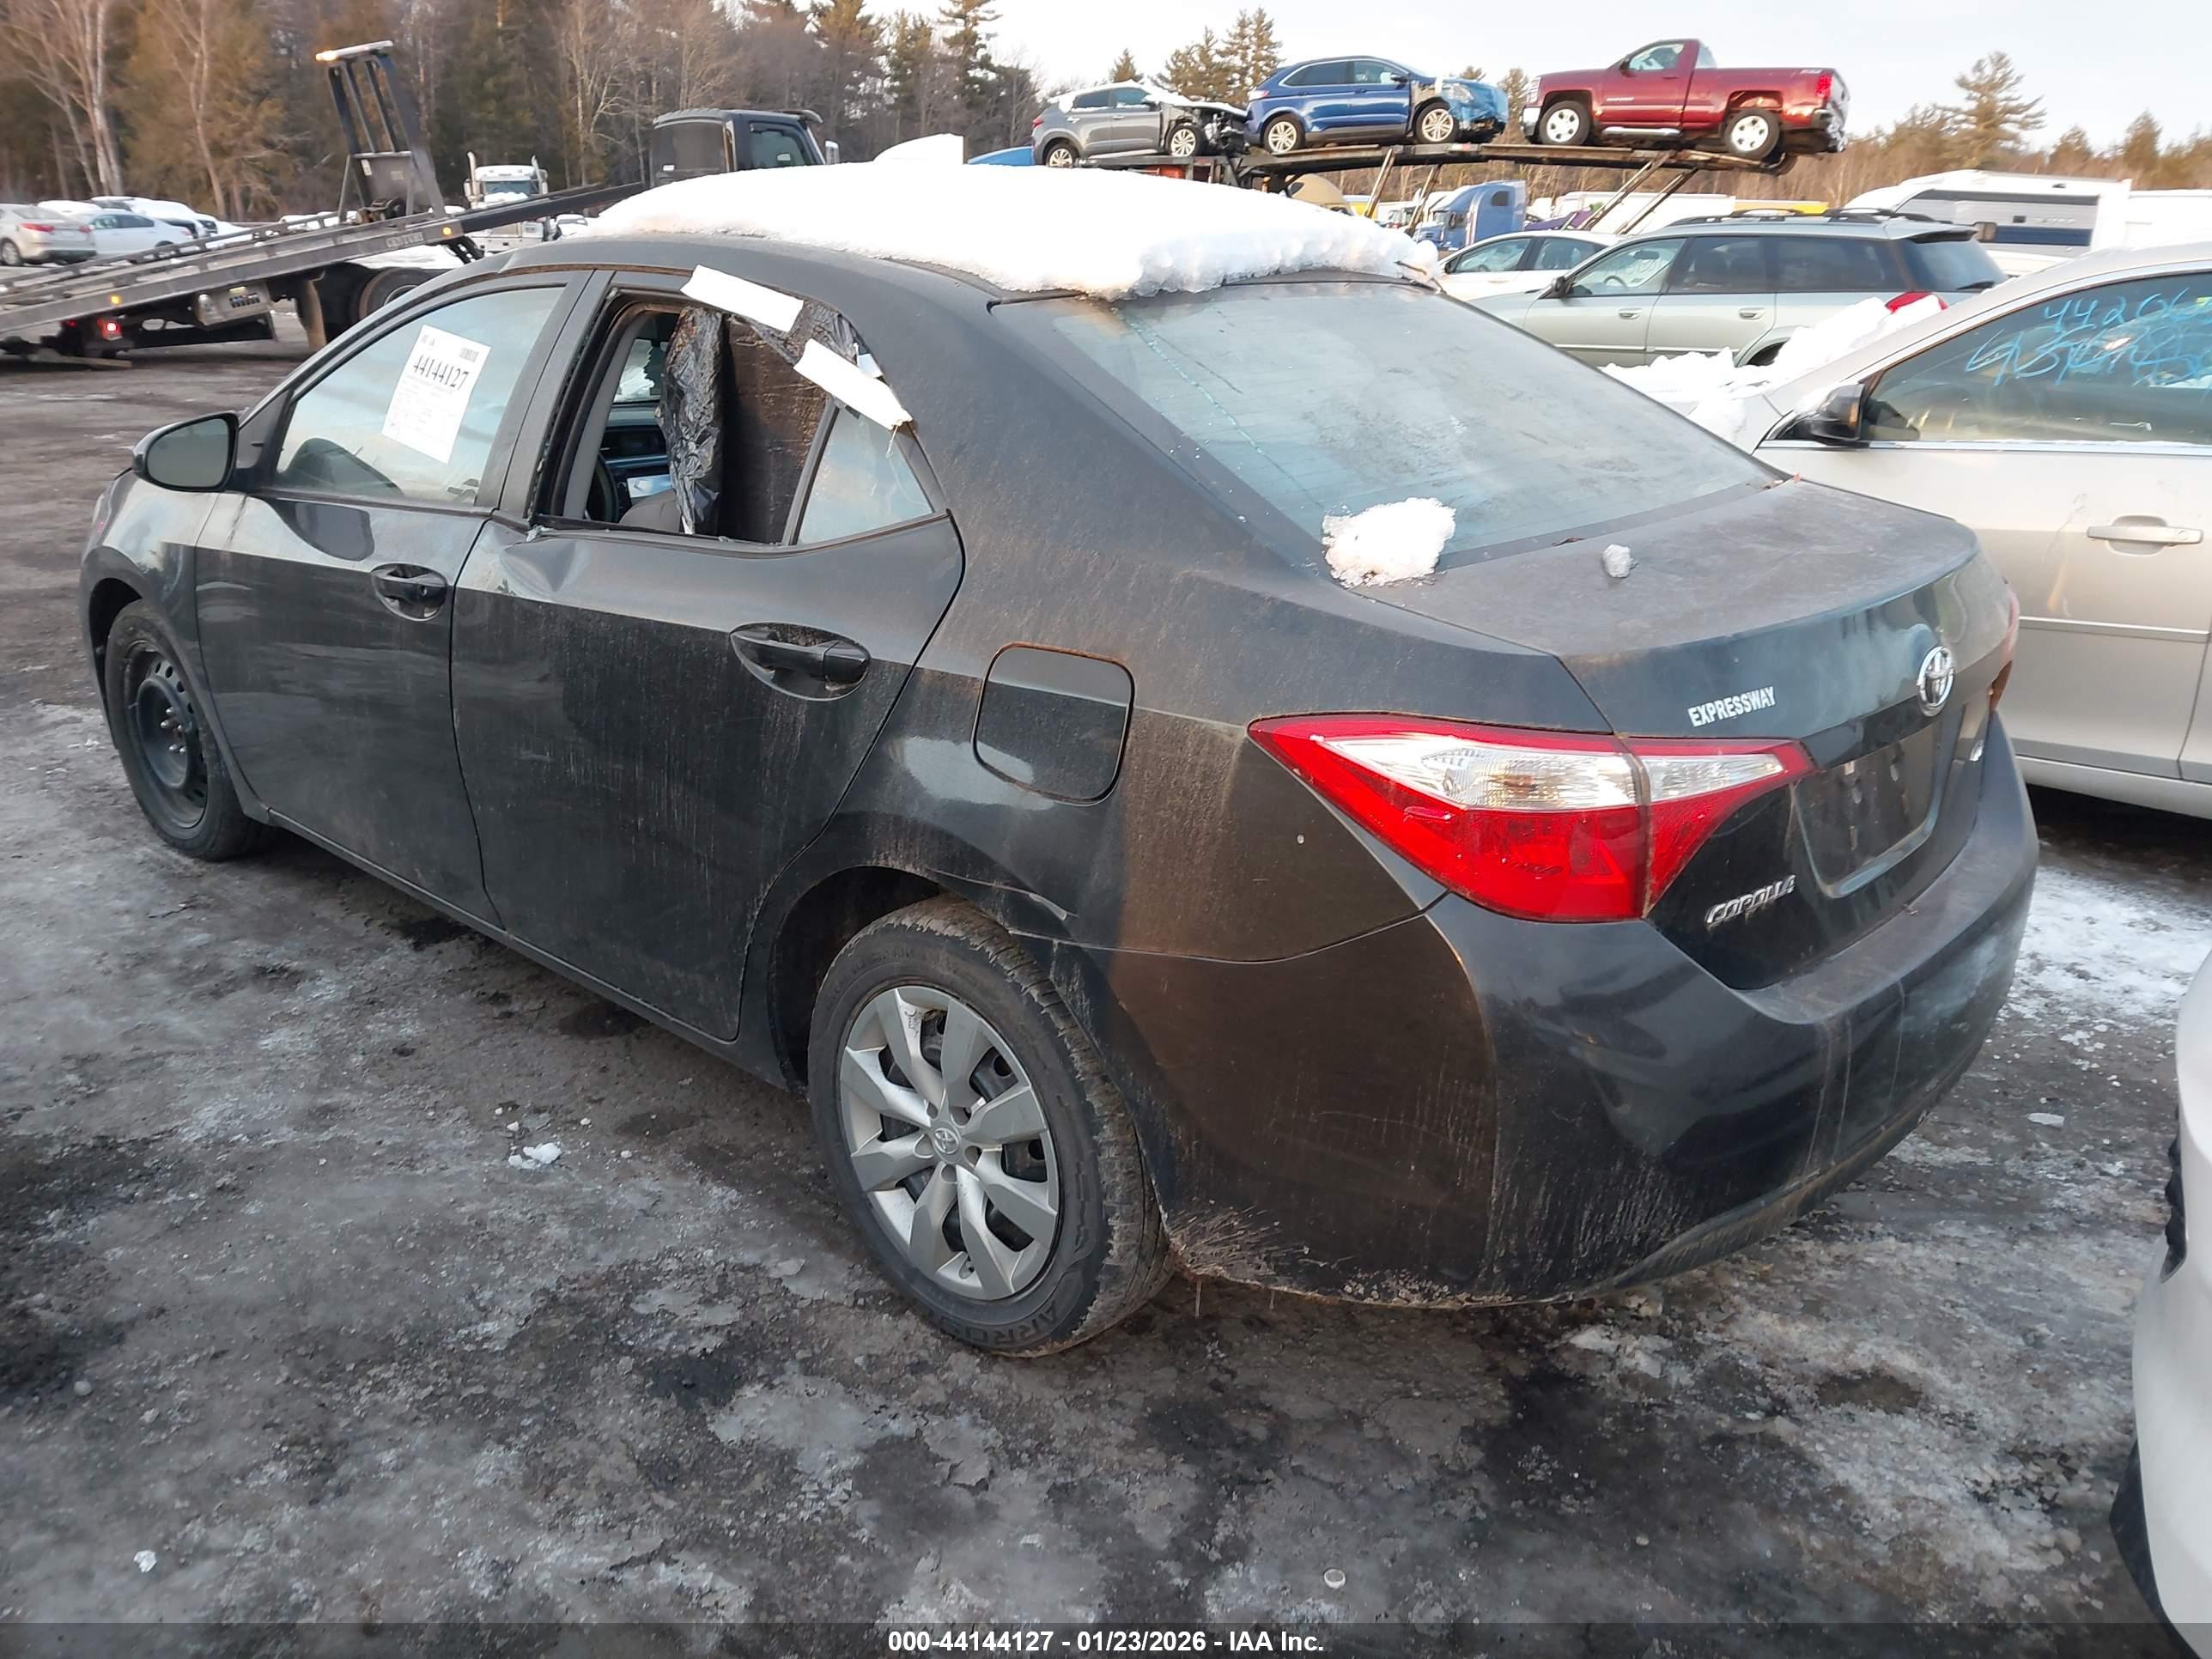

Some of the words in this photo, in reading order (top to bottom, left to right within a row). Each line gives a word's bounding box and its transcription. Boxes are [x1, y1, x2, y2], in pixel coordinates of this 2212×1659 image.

[413, 354, 471, 392] 44144127
[1687, 686, 1776, 727] EXPRESSWAY
[1705, 874, 1796, 927] COROLLA
